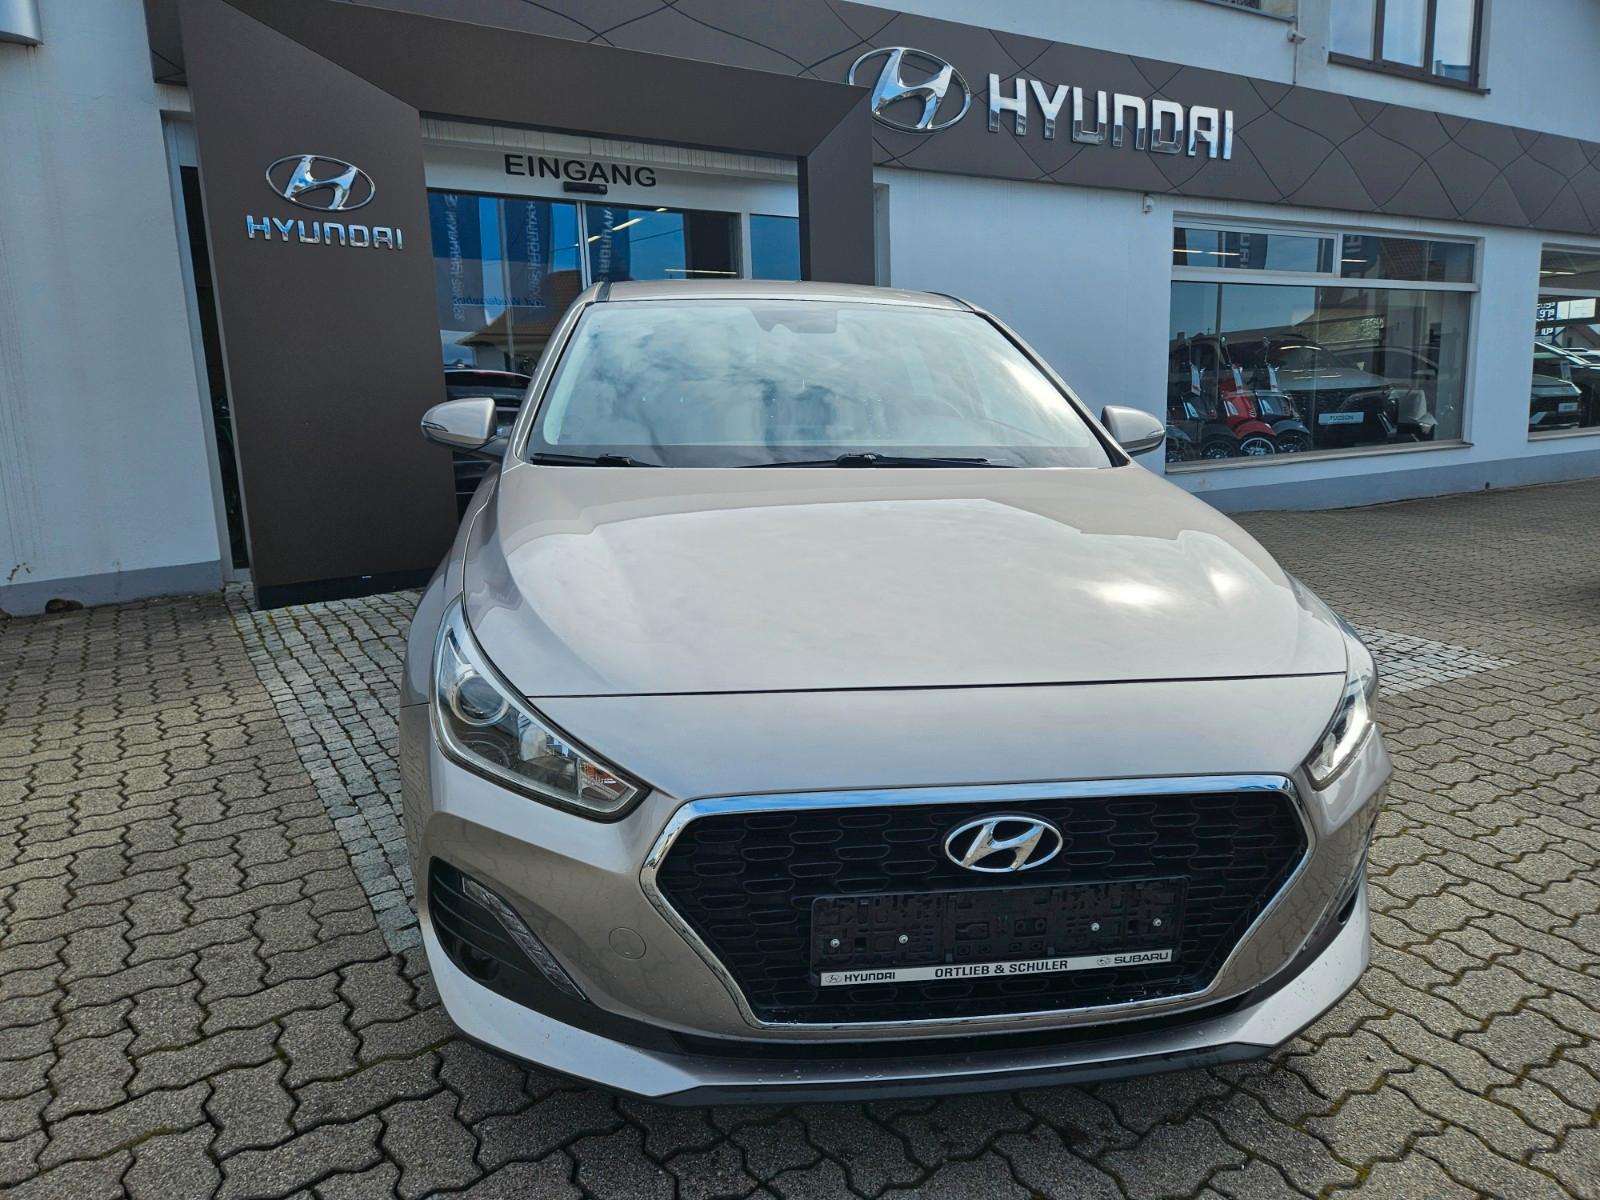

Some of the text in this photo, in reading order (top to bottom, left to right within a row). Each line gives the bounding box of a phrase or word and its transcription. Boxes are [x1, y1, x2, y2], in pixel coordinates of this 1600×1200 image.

[988, 72, 1234, 160] HYUNDAI
[504, 153, 657, 188] EINGANG
[246, 214, 404, 250] HYUNDAI
[844, 952, 1169, 983] HYUNDAI ORTLIEB & SCHULER SUBARU
